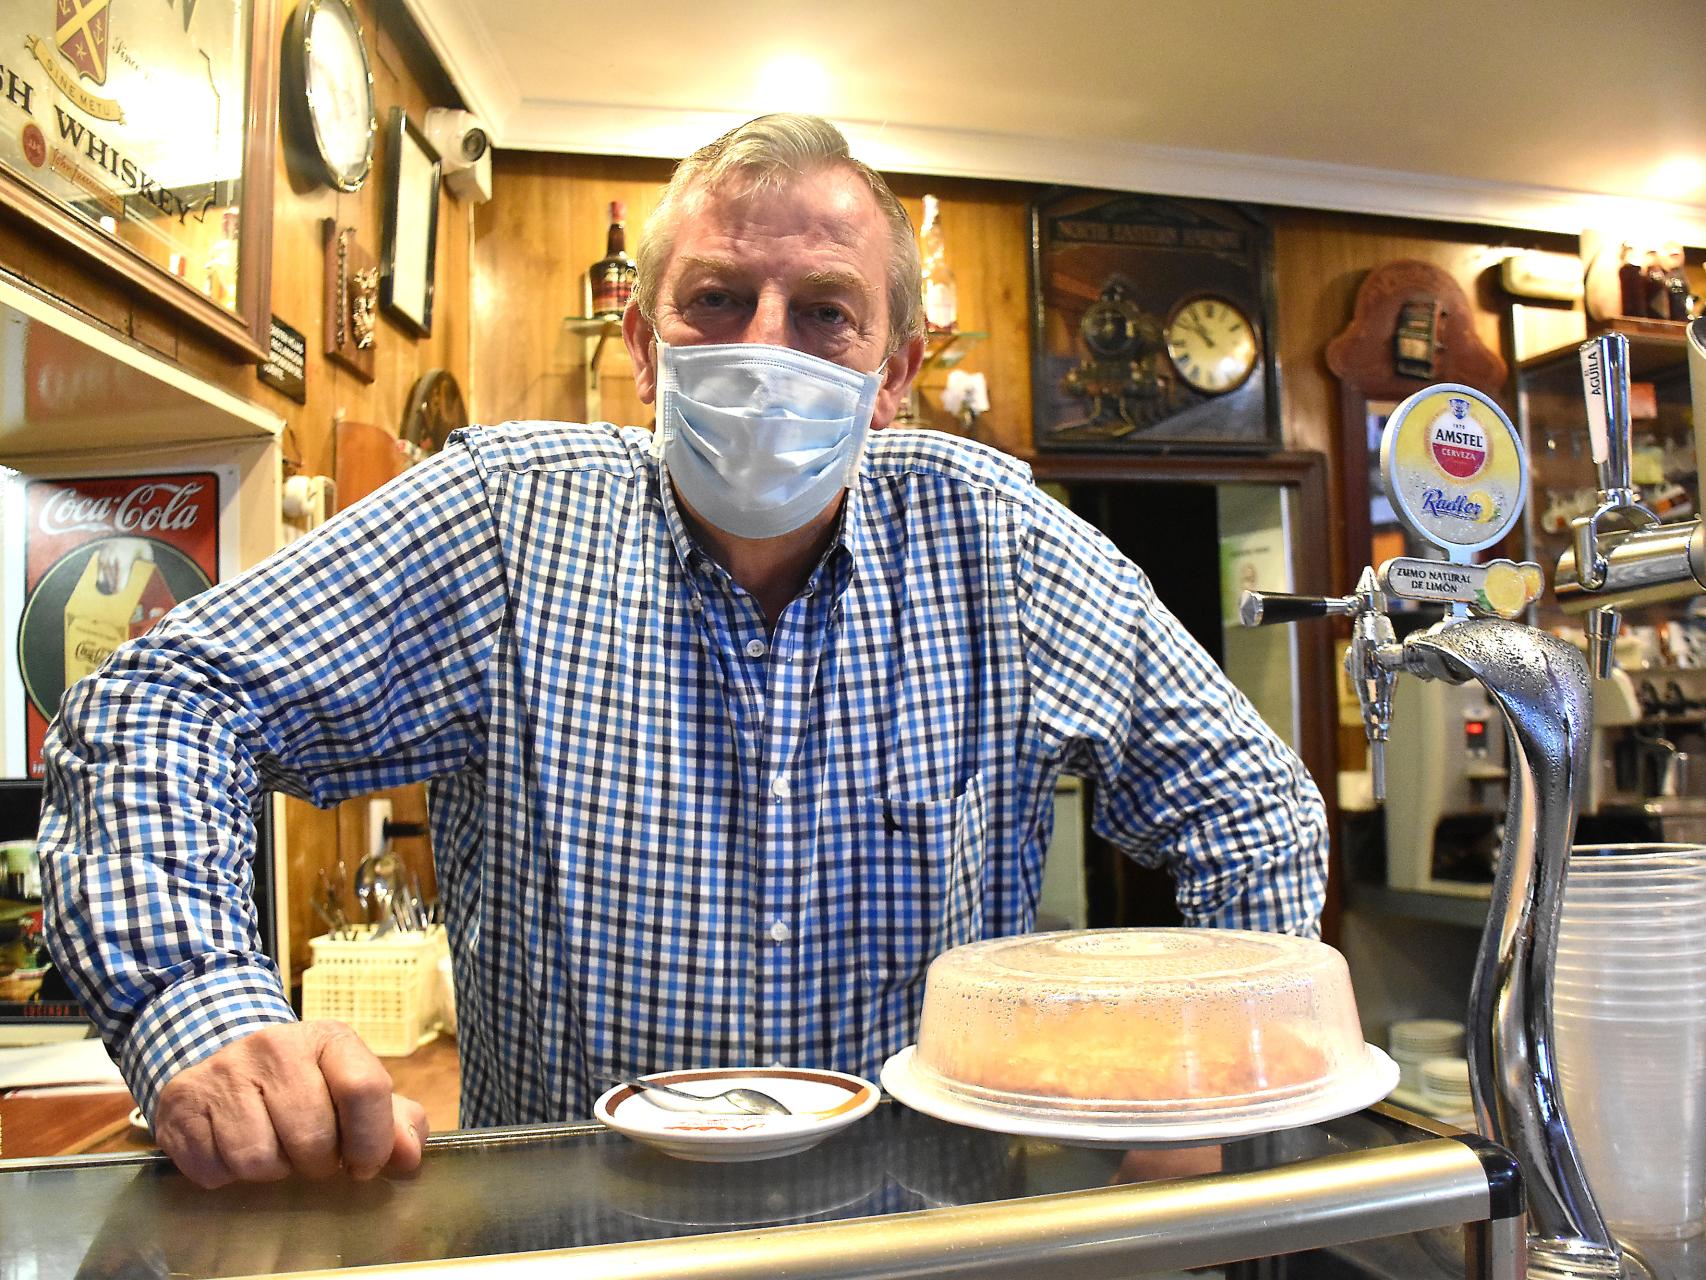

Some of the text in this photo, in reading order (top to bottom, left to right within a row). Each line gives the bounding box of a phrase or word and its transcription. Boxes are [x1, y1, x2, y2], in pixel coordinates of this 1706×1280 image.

[46, 58, 77, 98] SINE
[0, 63, 34, 116] H
[54, 104, 192, 225] WHISKEY
[1588, 351, 1602, 396] AGUILA
[1435, 428, 1484, 448] AMSTEL
[1441, 448, 1477, 461] CERVEZA
[38, 481, 204, 536] Coca-Cola
[1423, 488, 1481, 518] Radler
[1397, 567, 1472, 584] ZUMO NATURAL
[1411, 580, 1458, 593] DE LIMÓN
